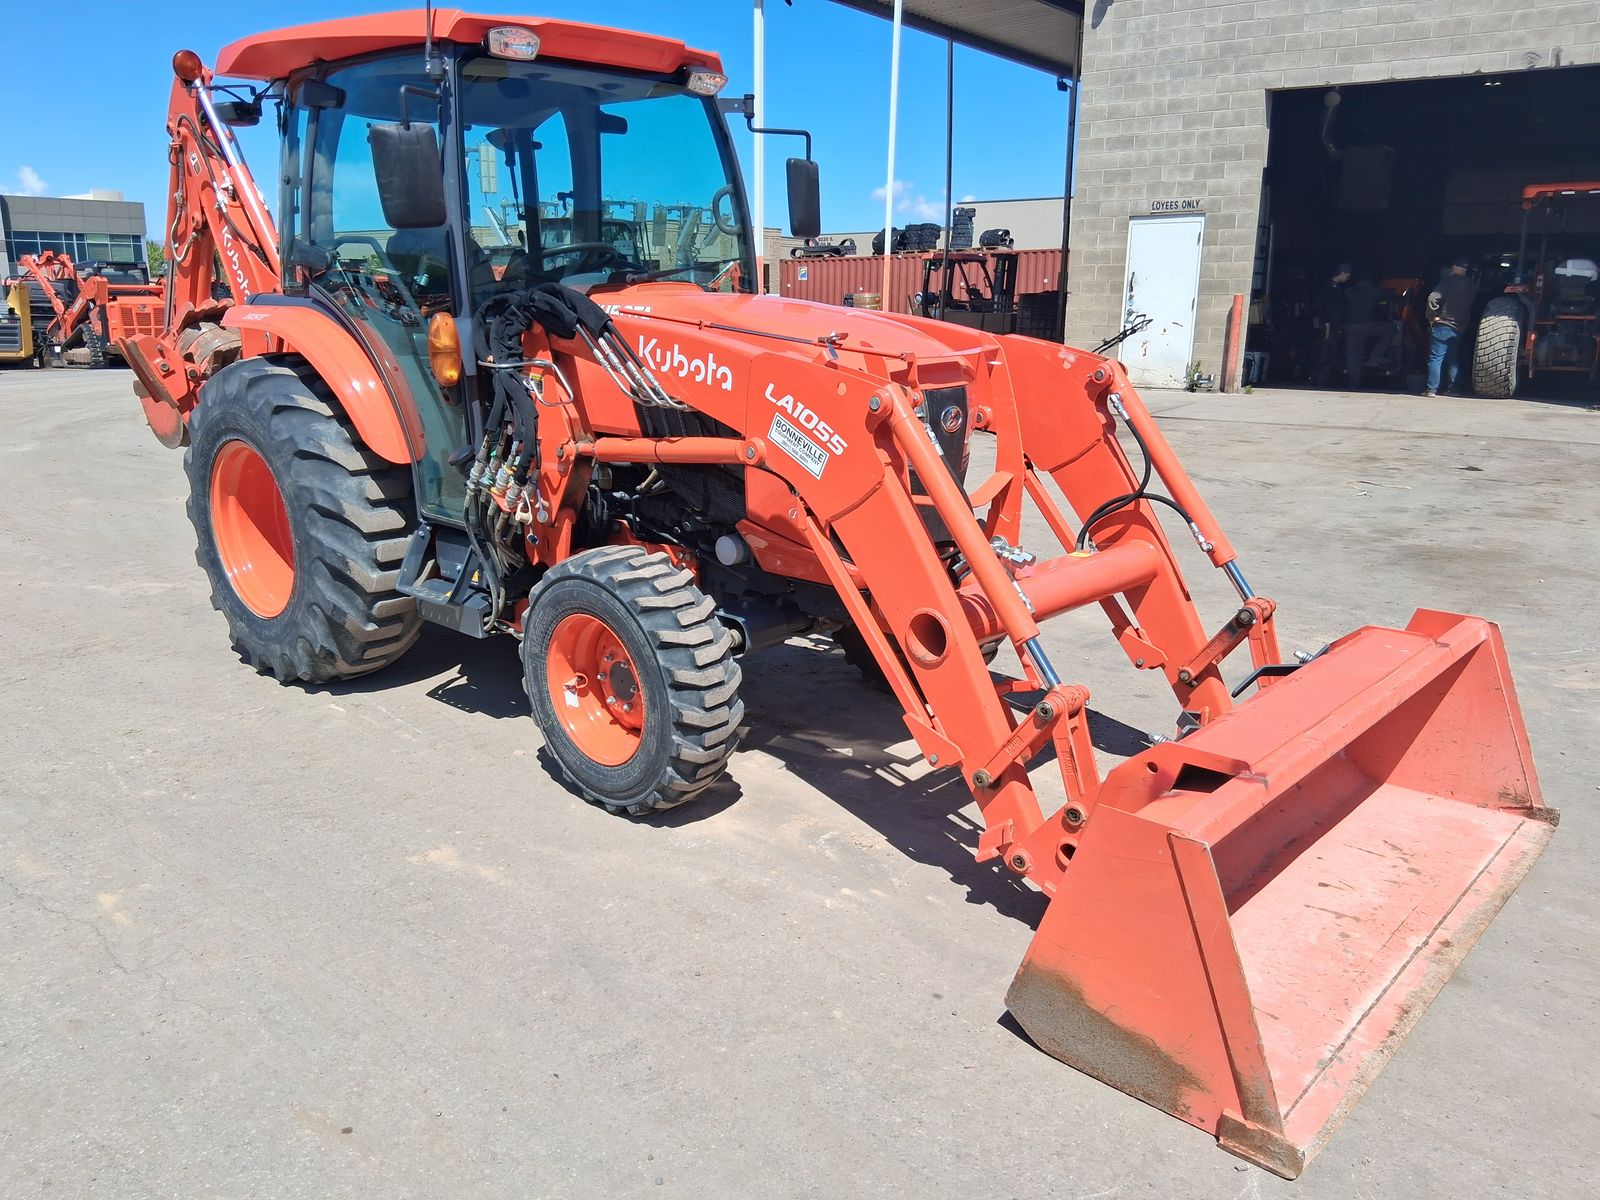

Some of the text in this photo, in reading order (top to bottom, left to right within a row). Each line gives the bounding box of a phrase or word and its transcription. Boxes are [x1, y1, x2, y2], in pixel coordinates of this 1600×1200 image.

[1152, 200, 1200, 210] LOYEES ONLY
[598, 303, 652, 320] UBOTA
[638, 334, 733, 391] Kubota
[764, 382, 848, 456] LA1055
[774, 428, 820, 466] EQUIPMENT COMPANY
[775, 419, 825, 463] BONNEVILLE
